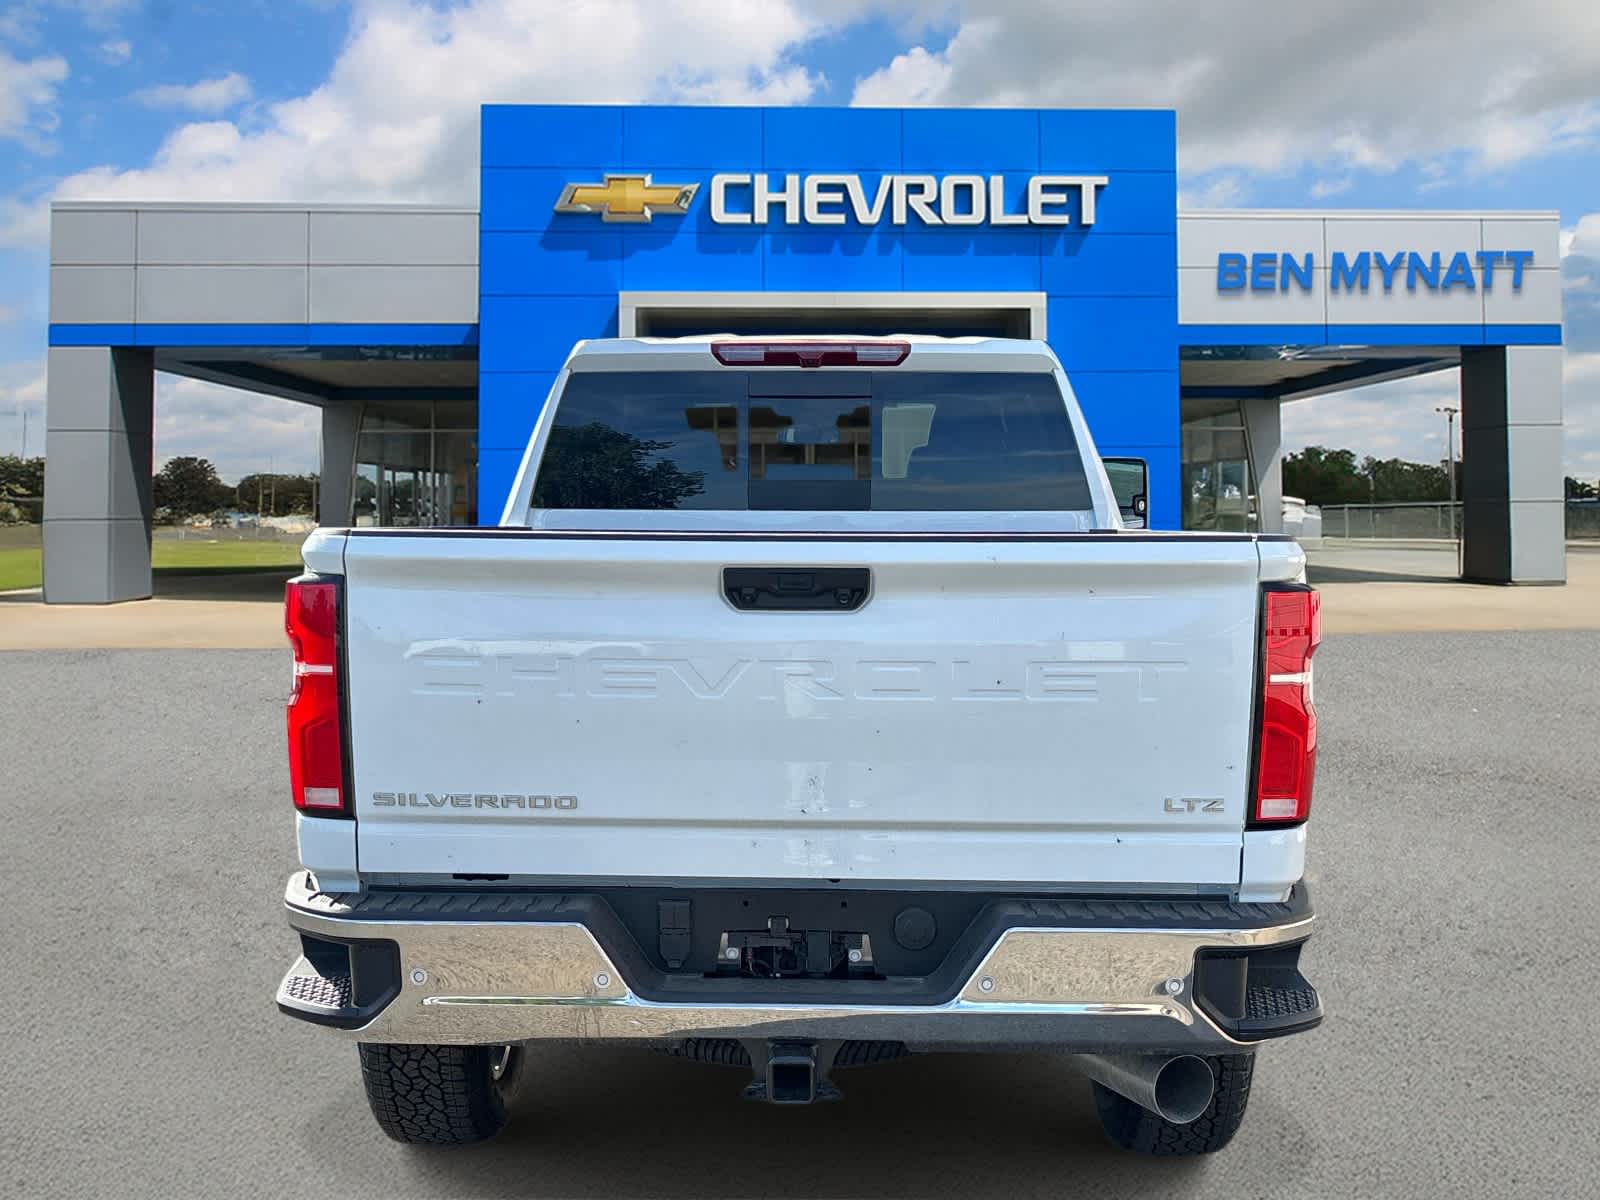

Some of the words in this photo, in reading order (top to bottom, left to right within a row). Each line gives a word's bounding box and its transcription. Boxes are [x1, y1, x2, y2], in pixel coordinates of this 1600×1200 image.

[710, 174, 1109, 225] CHEVROLET
[1217, 252, 1313, 291] BEN
[1330, 250, 1534, 290] MYNATT
[410, 655, 1189, 702] CHEVROLET
[372, 792, 578, 809] SILVERADO
[1164, 798, 1225, 812] LTZ
